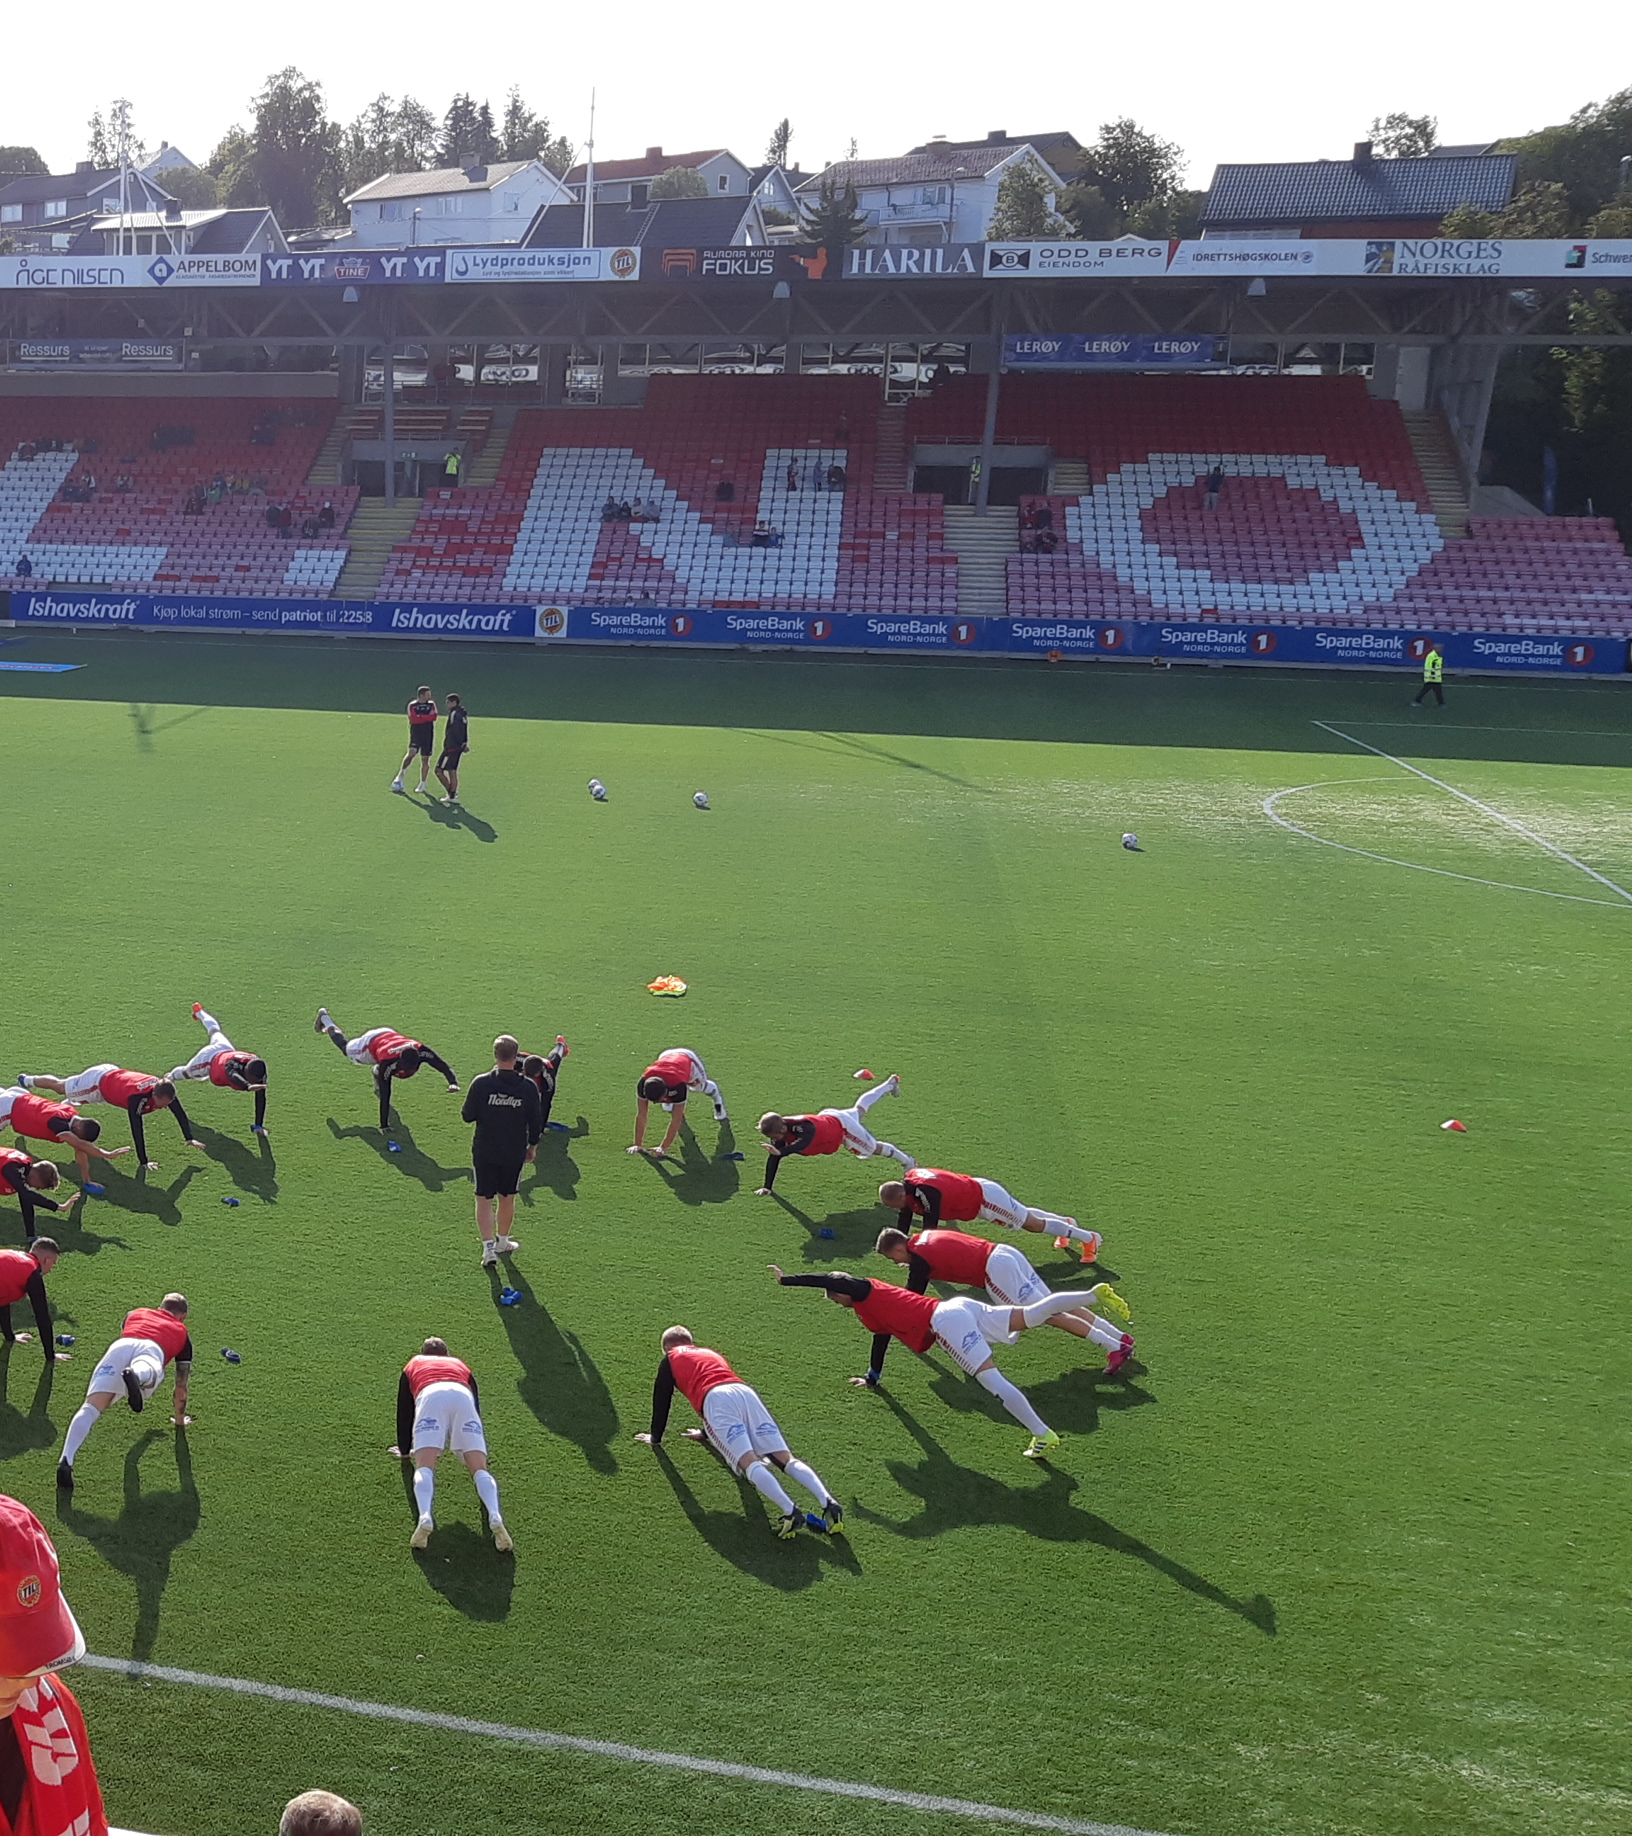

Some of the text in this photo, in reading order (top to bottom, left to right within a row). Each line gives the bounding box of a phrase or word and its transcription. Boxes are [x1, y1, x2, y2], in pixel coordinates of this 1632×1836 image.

[703, 249, 775, 258] AURORA KINO
[1040, 247, 1163, 258] ODD BERG
[1192, 252, 1298, 262] IDRETTSHØGSKOLEN
[1399, 241, 1502, 259] NORGES
[176, 259, 257, 274] APPELBOM
[472, 252, 592, 270] Lydproduksjon
[616, 257, 630, 269] TIL
[702, 259, 774, 275] FOKUS
[850, 247, 976, 275] HARILA
[1397, 259, 1500, 275] RÅFISKLAG
[16, 259, 125, 286] ÅGE NILSEN
[339, 267, 365, 276] TINE
[20, 343, 70, 356] Ressurs
[122, 342, 173, 356] Ressurs
[1015, 341, 1201, 353] LERØY LERØY LERØY
[27, 597, 138, 620] Ishavskraft
[153, 605, 177, 621] Kjøp
[181, 605, 206, 619] lokal
[209, 608, 241, 619] strøm
[251, 608, 279, 621] send
[281, 609, 322, 624] patriot
[326, 610, 337, 622] til
[339, 611, 373, 624] 2258
[391, 607, 512, 631] Ishavskraft
[543, 615, 559, 627] TIL
[590, 613, 685, 632] SpareBank 1
[726, 616, 824, 637] SpareBank 1
[610, 628, 667, 636] NORD-NORGE
[746, 631, 805, 641] NORD-NORGE
[866, 620, 968, 640] SpareBank 1
[1012, 624, 1115, 645] SpareBank 1
[887, 635, 948, 643] NORD-NORGE
[1033, 639, 1095, 648] NORD-NORGE
[1161, 629, 1267, 650] SpareBank 1
[1315, 633, 1424, 655] SpareBank 1
[1183, 644, 1246, 653] NORD-NORGE
[1337, 649, 1403, 659] NORD-NORGE
[1473, 639, 1585, 662] SpareBank 1
[1496, 656, 1563, 666] NORD-NORGE
[488, 1093, 522, 1108] Nordlys
[22, 1583, 38, 1599] TIL
